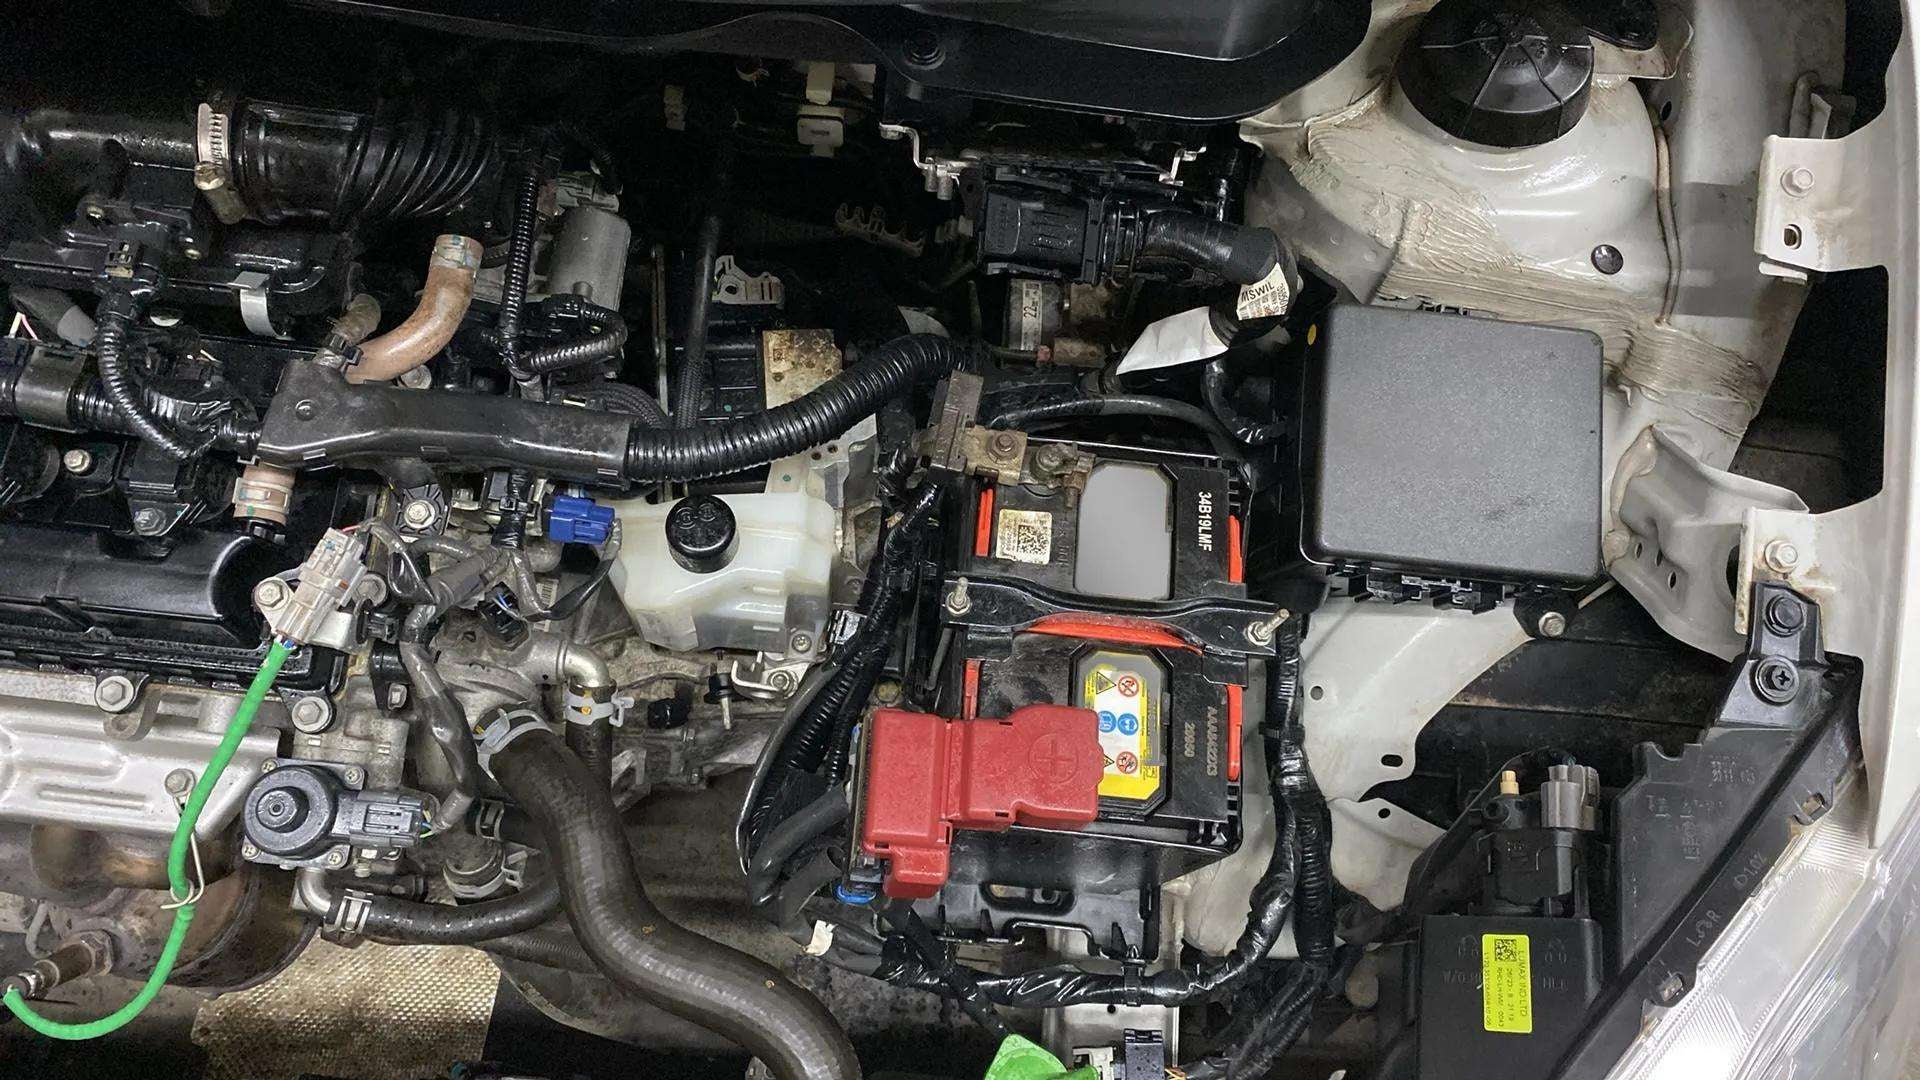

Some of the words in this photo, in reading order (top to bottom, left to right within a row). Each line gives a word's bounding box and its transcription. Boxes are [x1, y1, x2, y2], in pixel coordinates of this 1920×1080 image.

[1241, 282, 1275, 302] MSWIL
[1198, 491, 1212, 552] 34B19LMF
[1518, 950, 1527, 980] LUMAX
